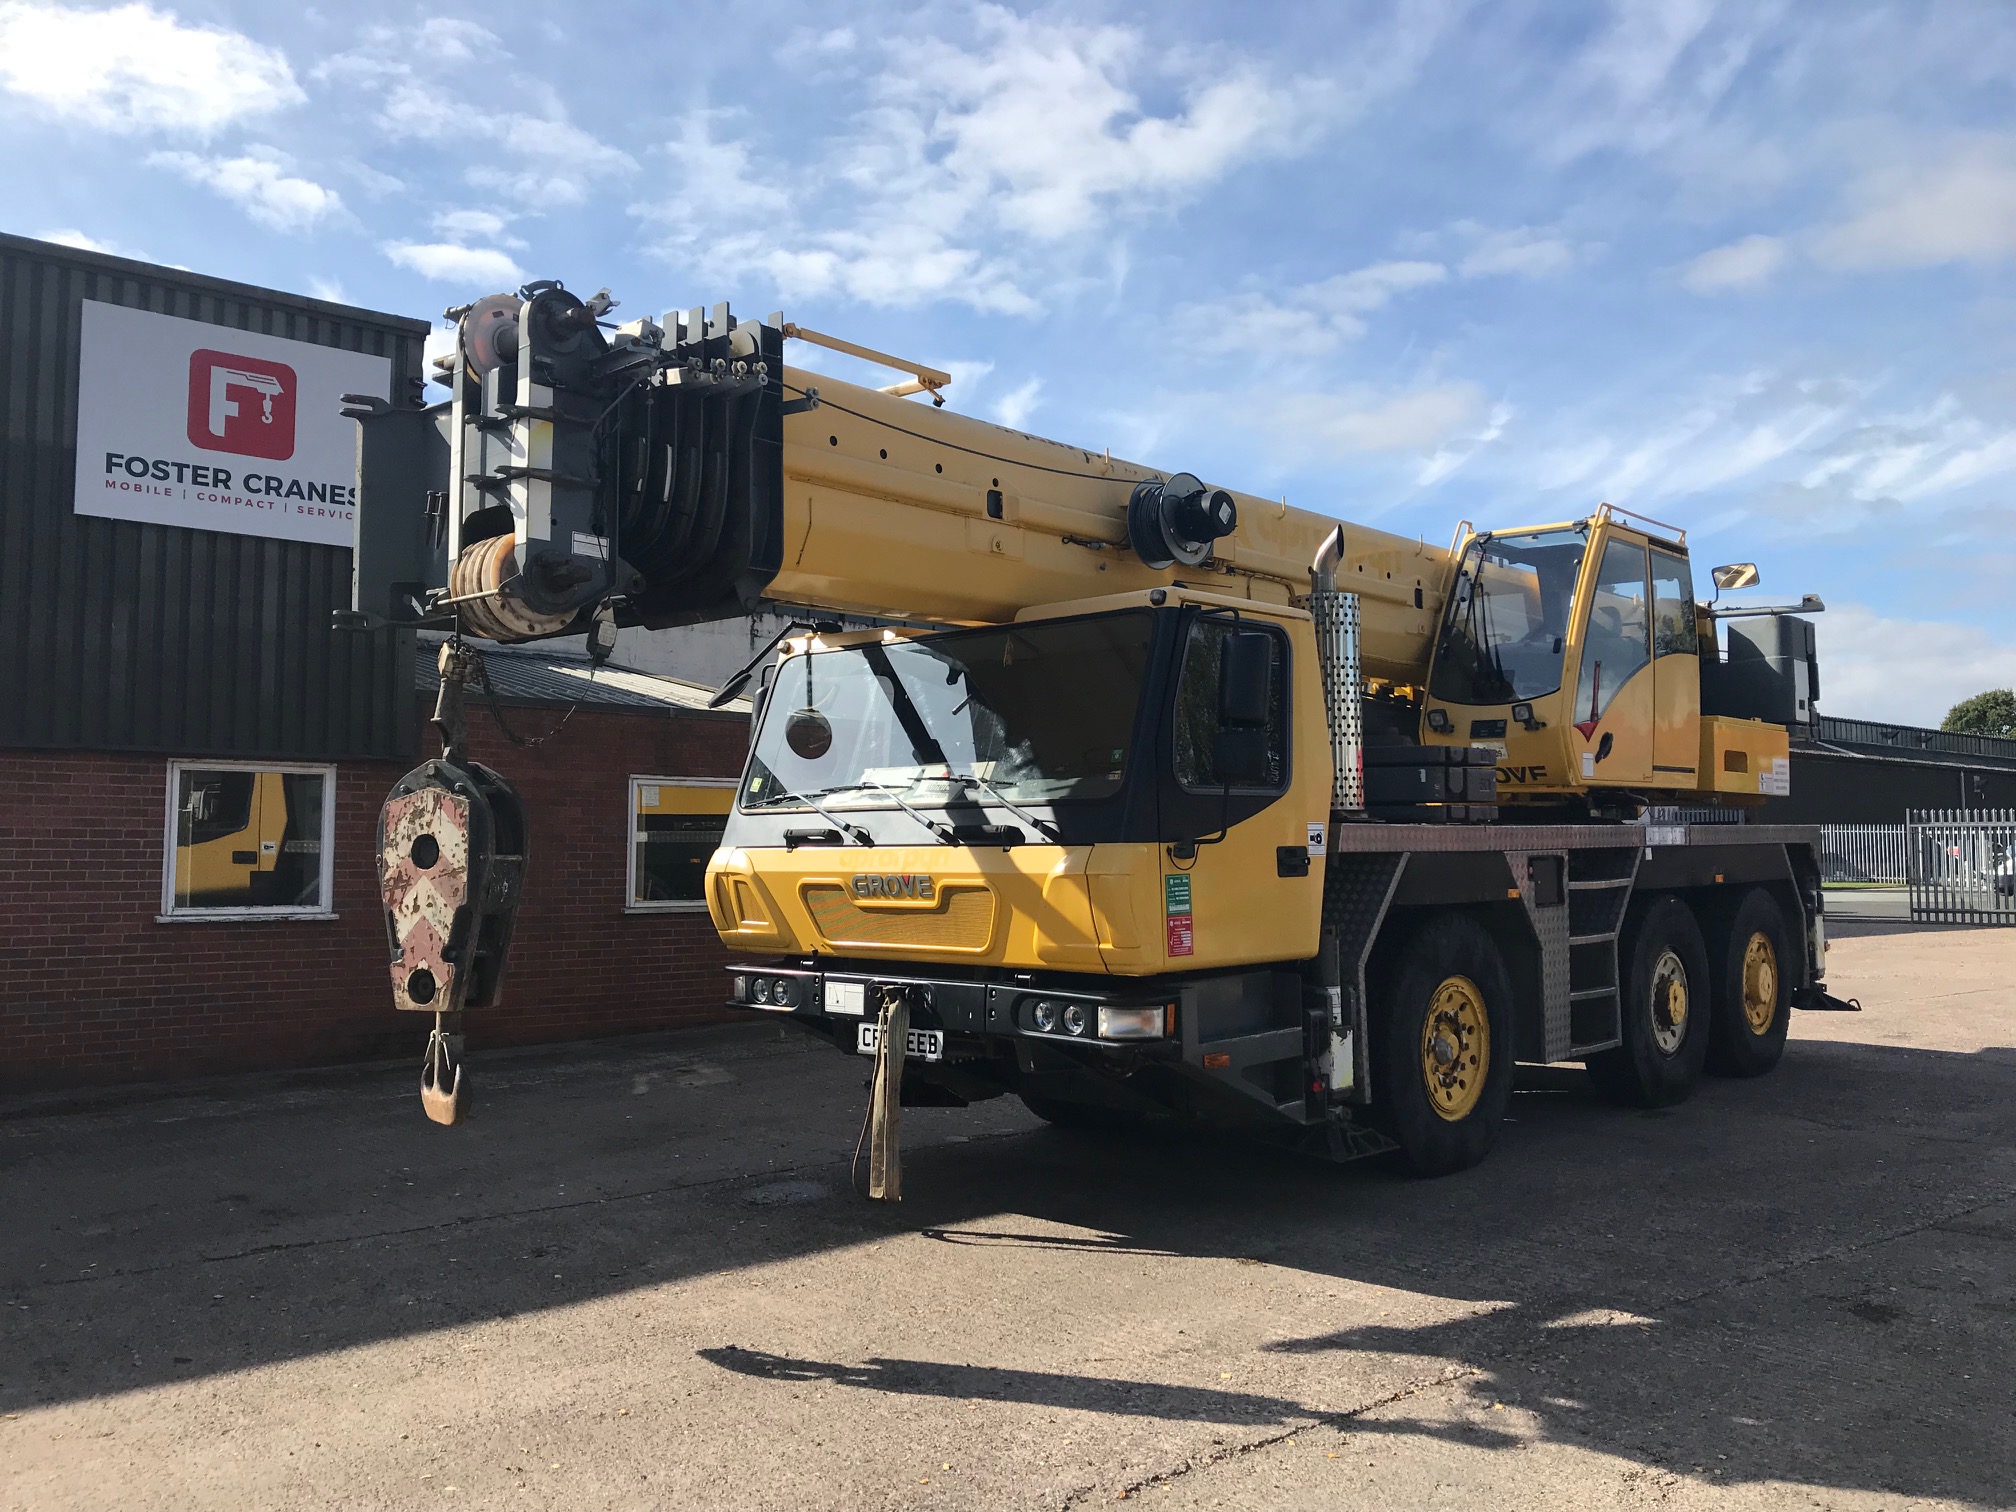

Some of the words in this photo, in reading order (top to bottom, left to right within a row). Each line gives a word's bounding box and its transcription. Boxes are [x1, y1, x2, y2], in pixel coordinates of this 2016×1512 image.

[105, 452, 232, 490] FOSTER
[105, 479, 172, 497] MOBILE
[197, 492, 275, 511] COMPACT
[297, 505, 353, 520] SERVIC
[851, 873, 933, 899] GROVE
[907, 1032, 938, 1054] EEB
